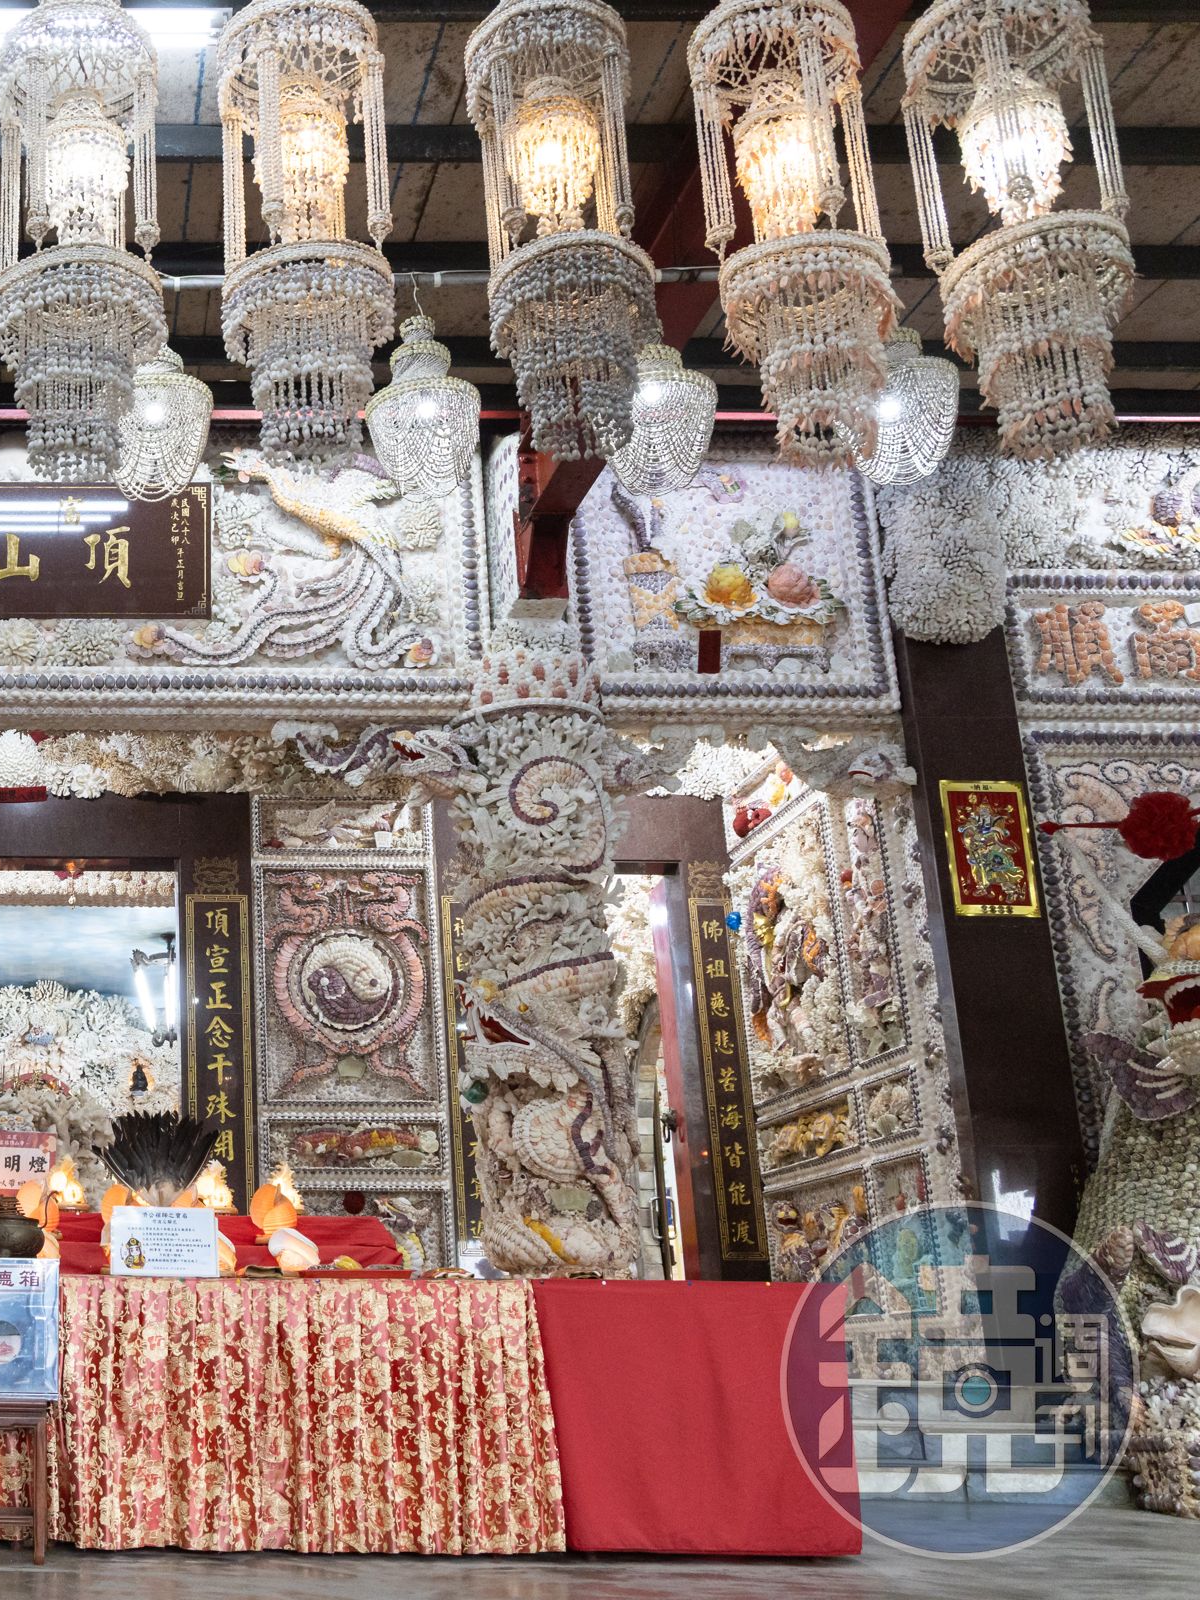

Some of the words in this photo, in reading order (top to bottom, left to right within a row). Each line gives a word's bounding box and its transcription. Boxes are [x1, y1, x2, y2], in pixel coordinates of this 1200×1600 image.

[204, 909, 236, 1192] 頂宣正念千殊開
[702, 919, 756, 1246] 佛祖慈悲苦海皆能渡
